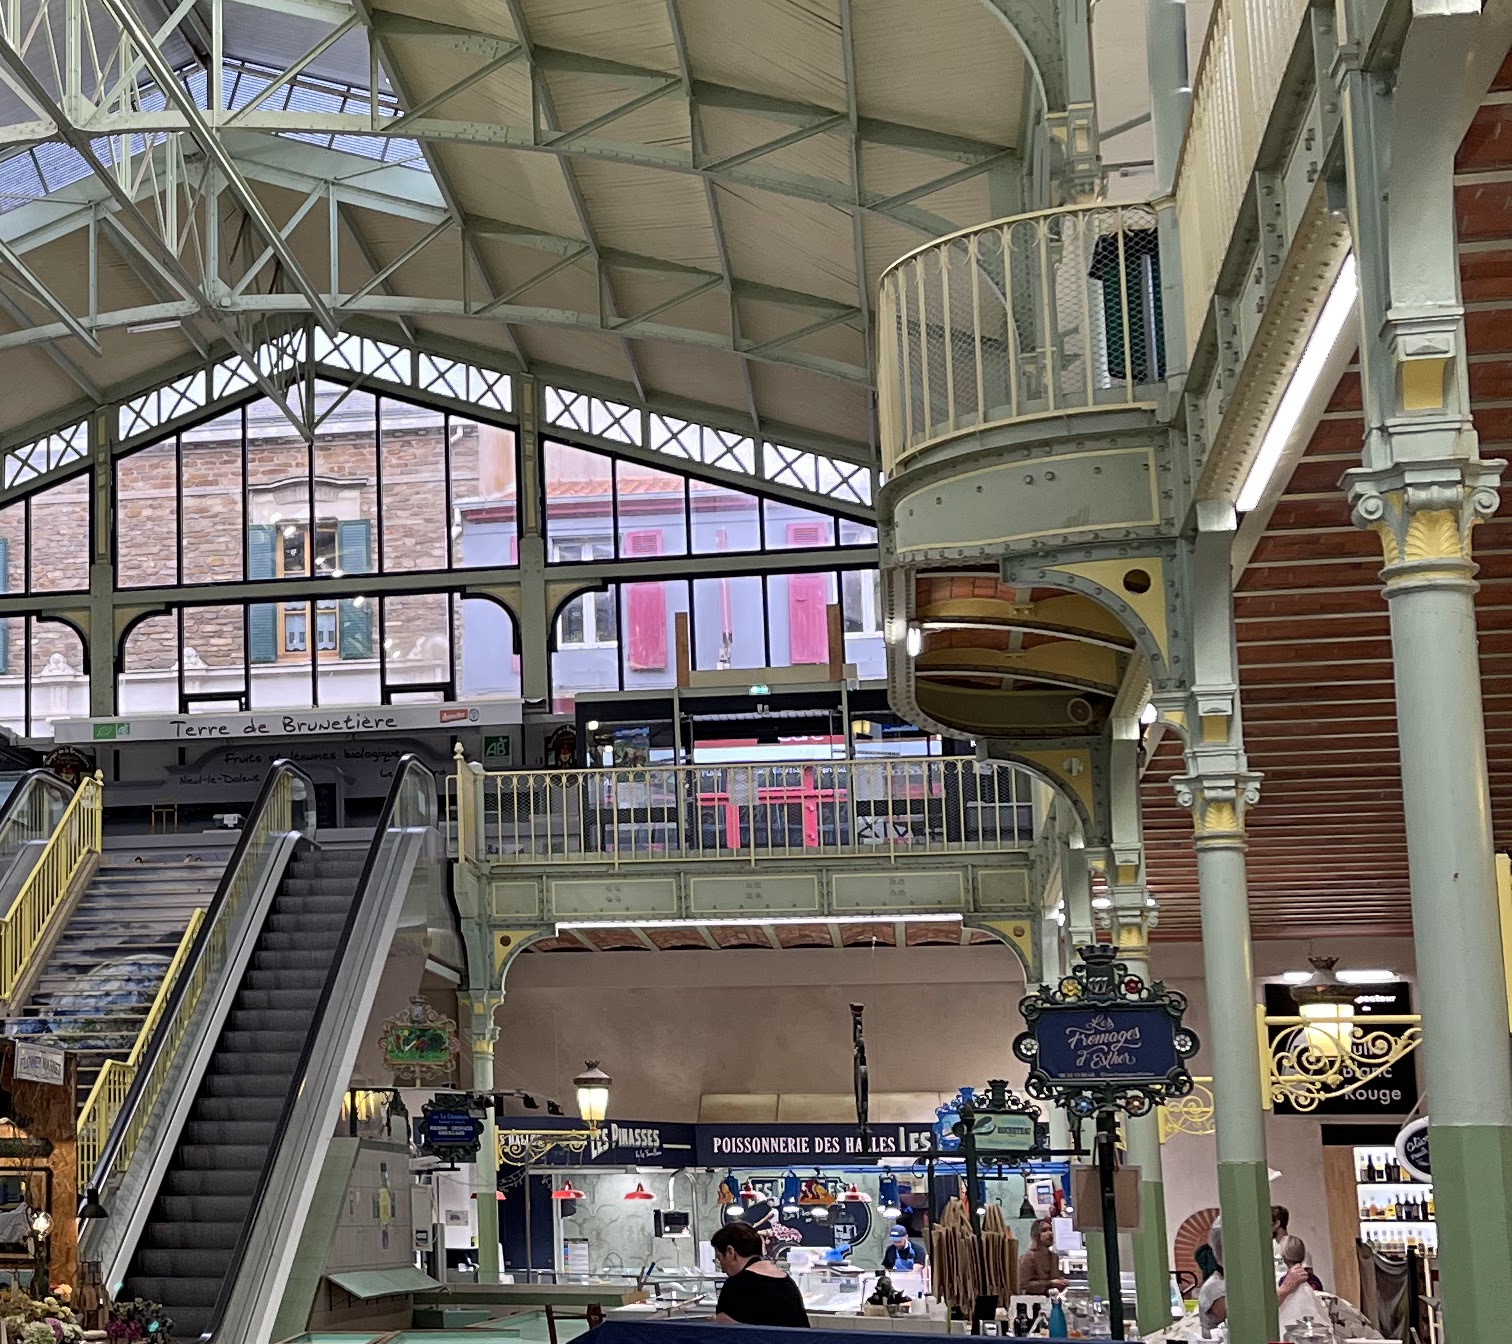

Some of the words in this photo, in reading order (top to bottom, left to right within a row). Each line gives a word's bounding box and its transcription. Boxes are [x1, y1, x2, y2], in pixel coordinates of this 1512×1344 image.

[170, 720, 231, 737] Terre
[243, 717, 270, 735] de
[1085, 1014, 1115, 1030] Les
[1066, 1027, 1141, 1051] Fromages
[1344, 1084, 1402, 1105] Rouge
[713, 1136, 810, 1154] POISSONNERIE
[814, 1136, 841, 1153] DES
